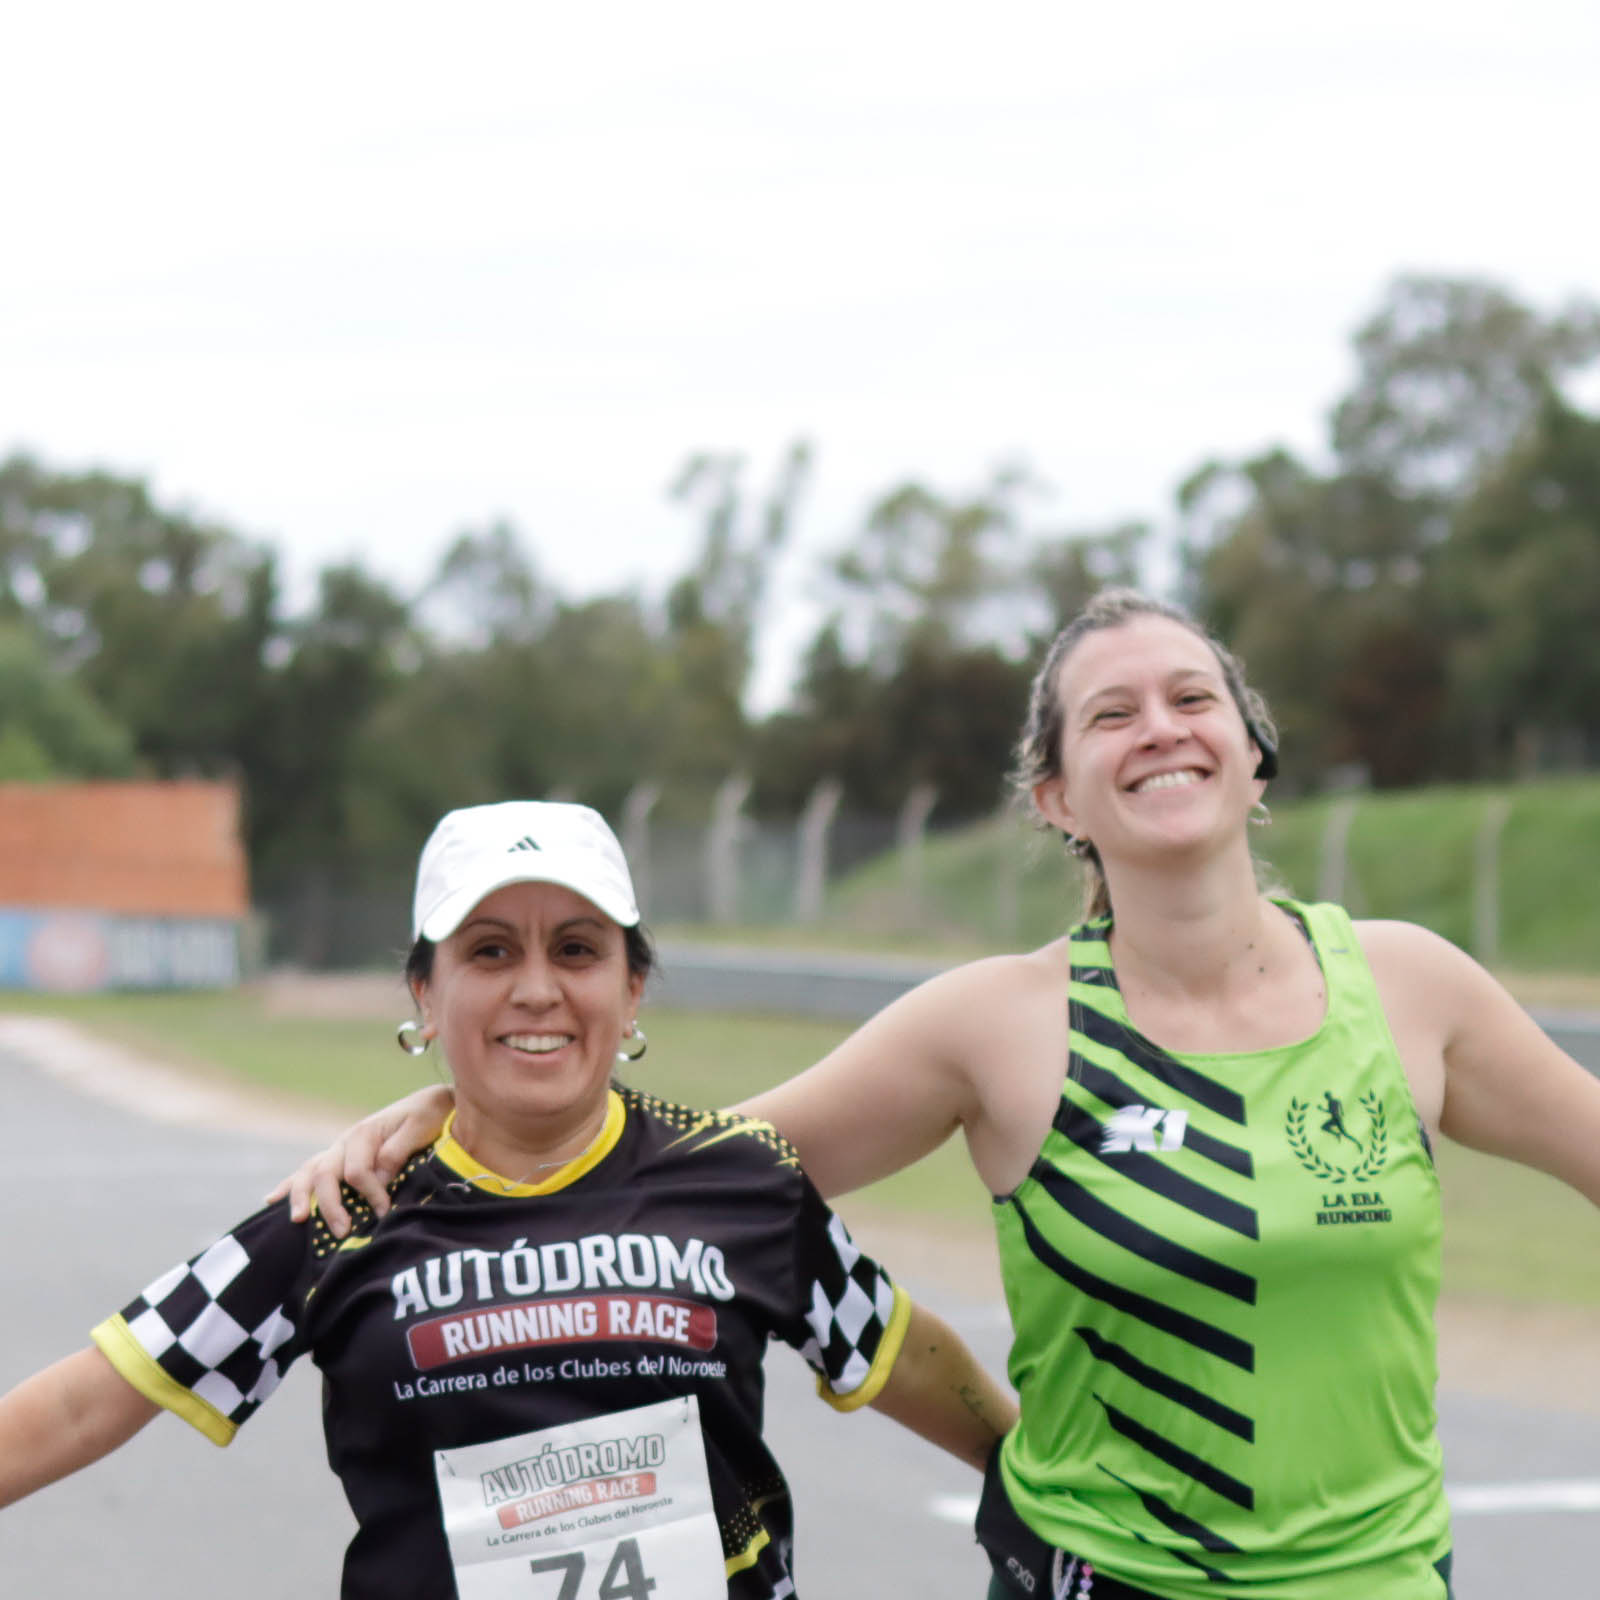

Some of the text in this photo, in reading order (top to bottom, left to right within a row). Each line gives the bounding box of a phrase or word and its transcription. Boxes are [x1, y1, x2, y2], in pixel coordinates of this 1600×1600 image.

[1316, 1208, 1392, 1225] RUNNING
[1322, 1194, 1347, 1208] LA
[391, 1233, 735, 1320] AUTÓDROMO
[441, 1299, 691, 1358] RUNNING RACE
[394, 1355, 727, 1400] La Carrera de los Clubes del Noroeste
[480, 1434, 665, 1507] AUTÓDROMO
[487, 1497, 673, 1546] La Carrera de los Clubes del Noroeste
[515, 1477, 640, 1522] RUNNING RACE
